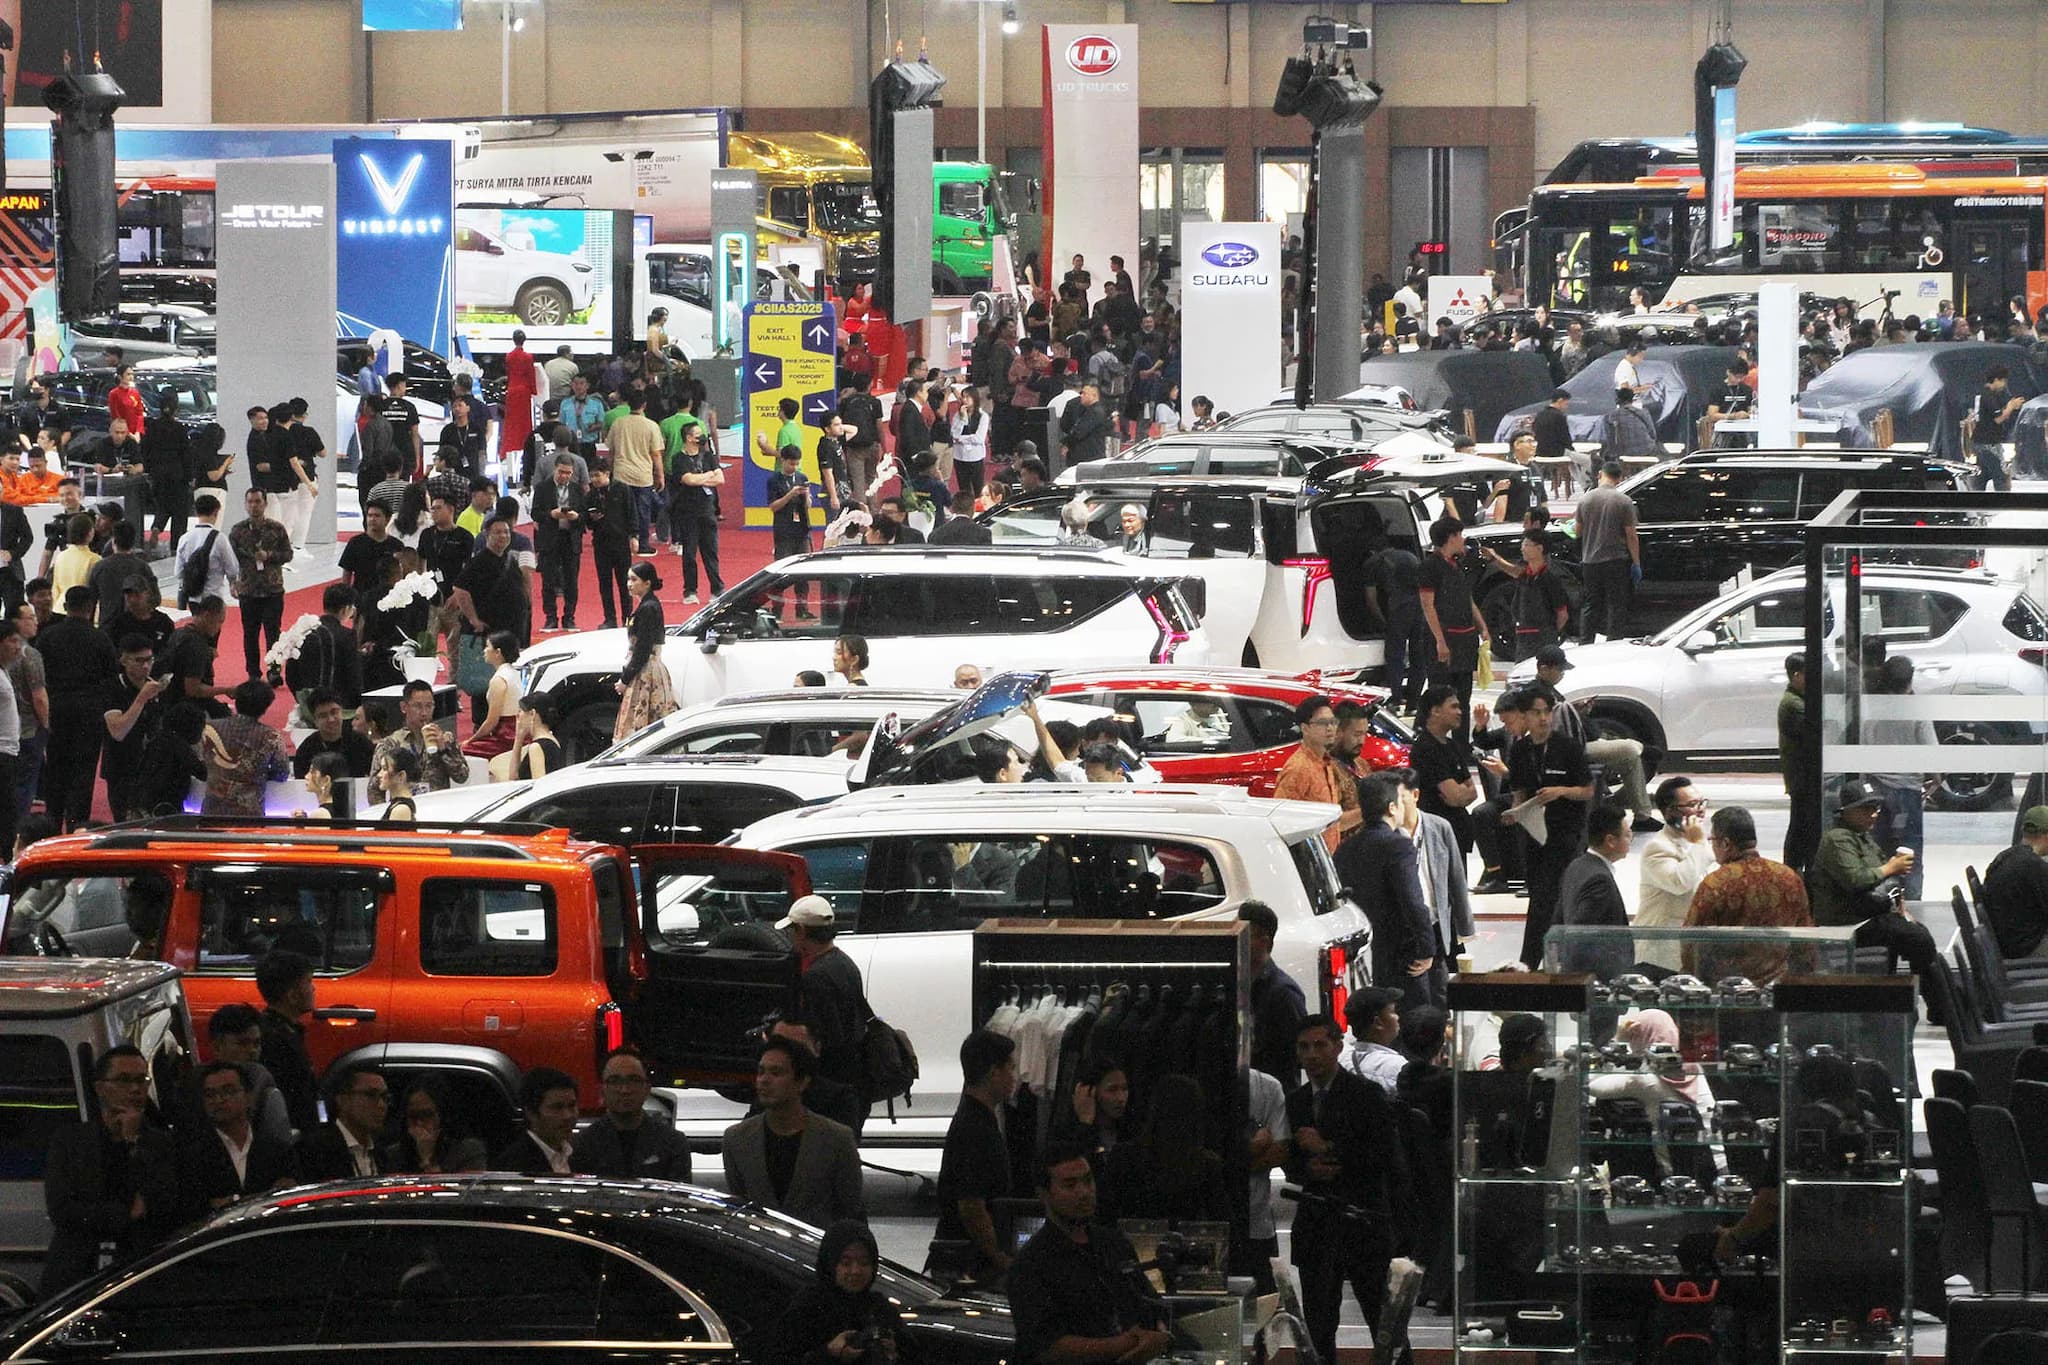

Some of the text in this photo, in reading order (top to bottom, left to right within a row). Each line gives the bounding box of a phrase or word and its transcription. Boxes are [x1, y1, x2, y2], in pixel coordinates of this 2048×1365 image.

[1071, 45, 1117, 66] UD
[1057, 82, 1129, 91] UD TRUCKS
[467, 178, 494, 190] SURYA
[496, 177, 525, 188] MITRA
[526, 176, 551, 187] TIRTA
[553, 175, 593, 186] KENCANA
[220, 204, 324, 218] JETOUR
[233, 219, 312, 228] Drive Your Future
[343, 219, 442, 234] VINFAST
[1192, 275, 1268, 286] SUBARU
[754, 303, 823, 314] #GIIAS2025
